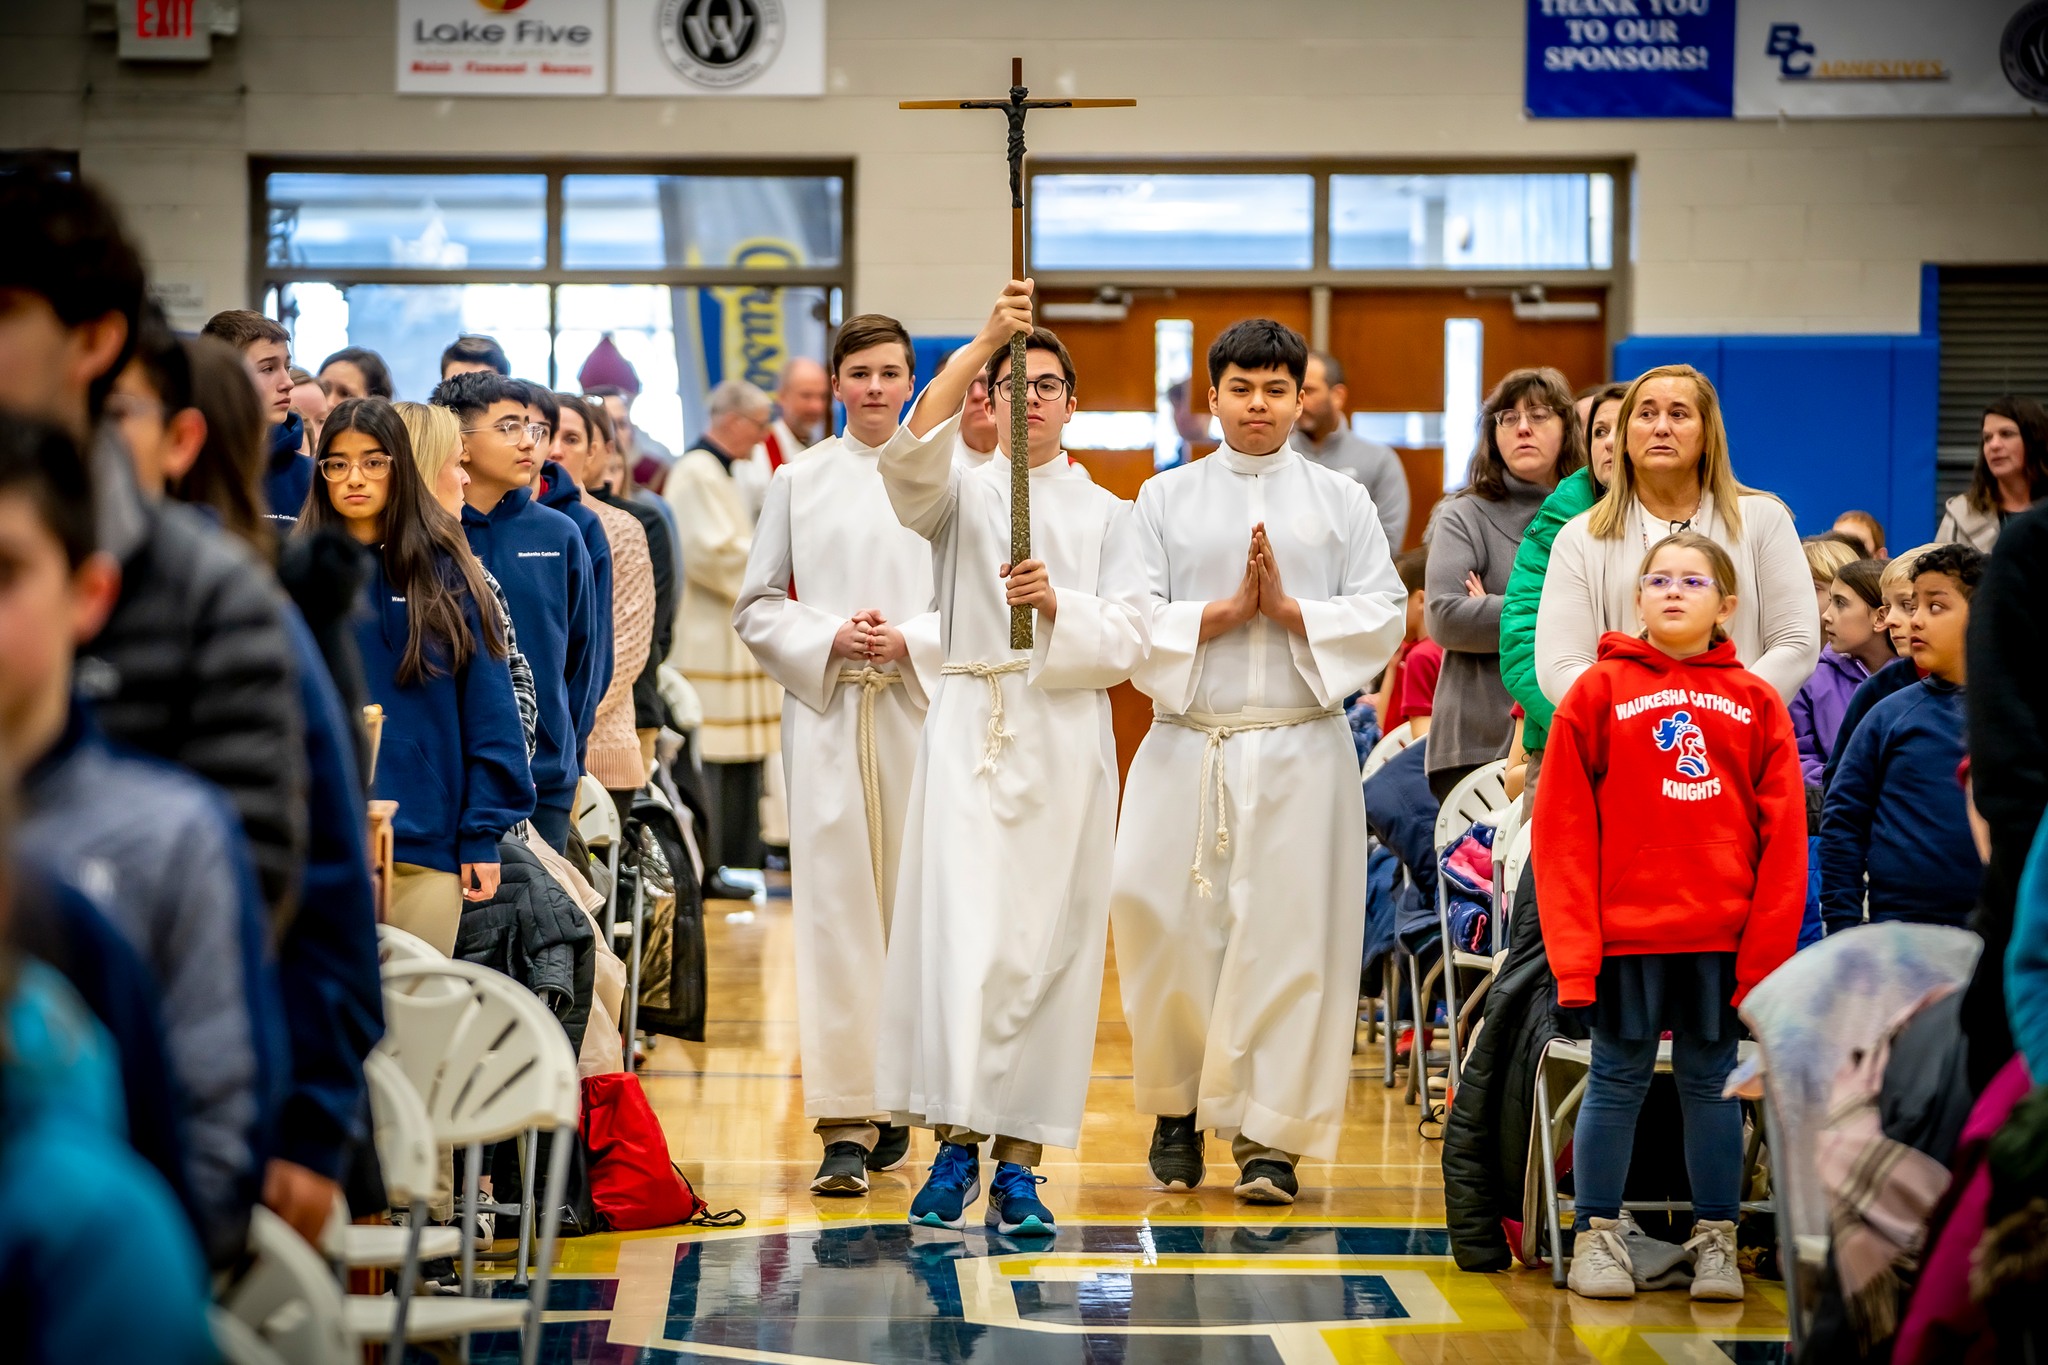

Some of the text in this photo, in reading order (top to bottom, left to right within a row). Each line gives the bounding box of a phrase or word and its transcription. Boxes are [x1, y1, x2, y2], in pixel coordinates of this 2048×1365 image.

[137, 0, 196, 38] EXIT
[1541, 0, 1709, 16] THANK YOU
[414, 19, 592, 45] Lake Five
[1565, 19, 1680, 43] TO OUR
[1544, 46, 1709, 71] SPONSORS!
[1615, 689, 1752, 725] WAUKESHA CATHOLIC
[1662, 777, 1722, 801] KNIGHTS
